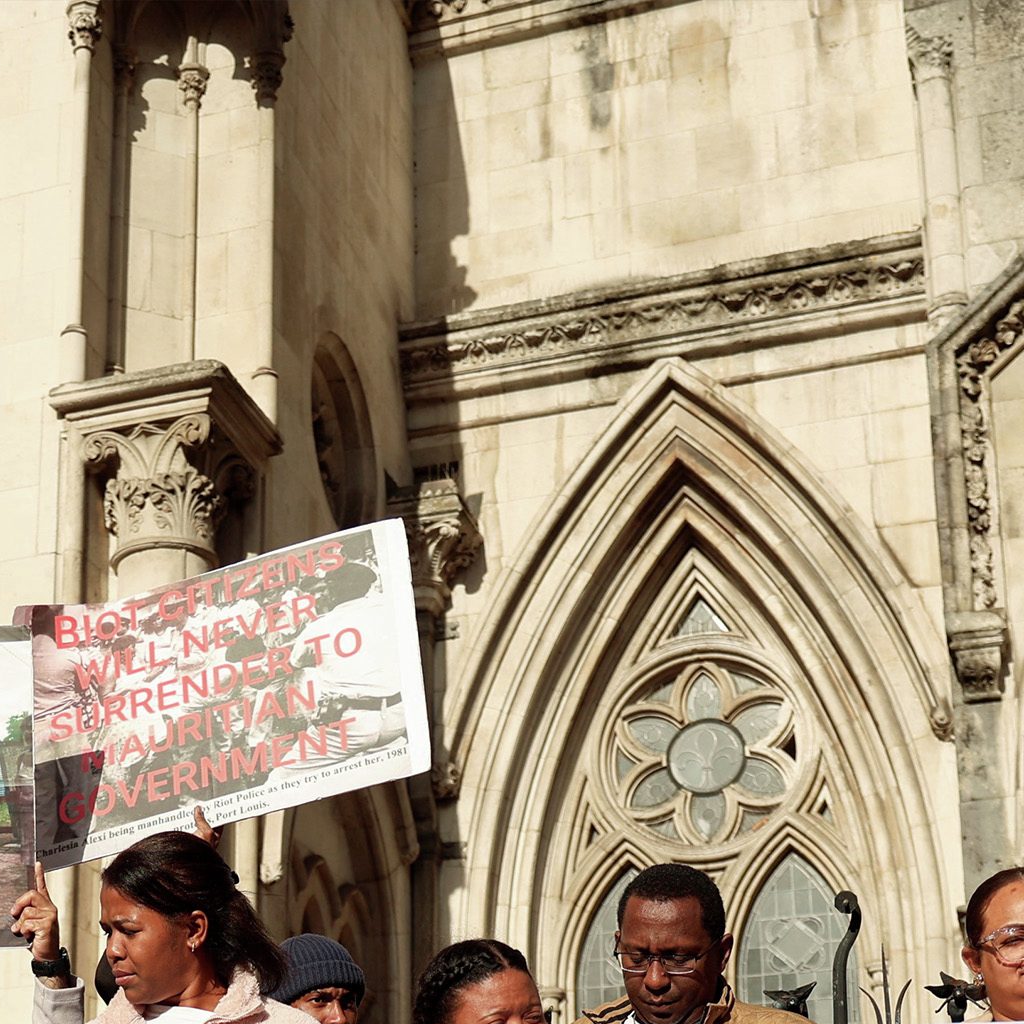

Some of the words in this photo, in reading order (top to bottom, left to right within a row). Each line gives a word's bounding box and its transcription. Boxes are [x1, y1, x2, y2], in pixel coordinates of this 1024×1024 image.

[54, 602, 145, 649] BIOT
[158, 541, 345, 621] CITIZENS
[76, 640, 170, 690] WILL
[182, 594, 318, 658] NEVER
[50, 647, 293, 742] SURRENDER
[304, 627, 362, 666] TO
[81, 680, 316, 773] MAURITIAN
[36, 841, 79, 859] Charlesia
[82, 833, 107, 847] Alexi
[109, 825, 136, 839] being
[214, 798, 234, 810] Riot
[236, 788, 266, 803] Police
[267, 785, 280, 793] as
[281, 779, 302, 791] they
[304, 773, 319, 784] try
[321, 770, 331, 778] to
[333, 761, 362, 775] arrest
[386, 747, 408, 760] 1981
[59, 718, 356, 824] GOVERNMENT
[215, 811, 237, 822] Port
[240, 801, 270, 815] Louis.
